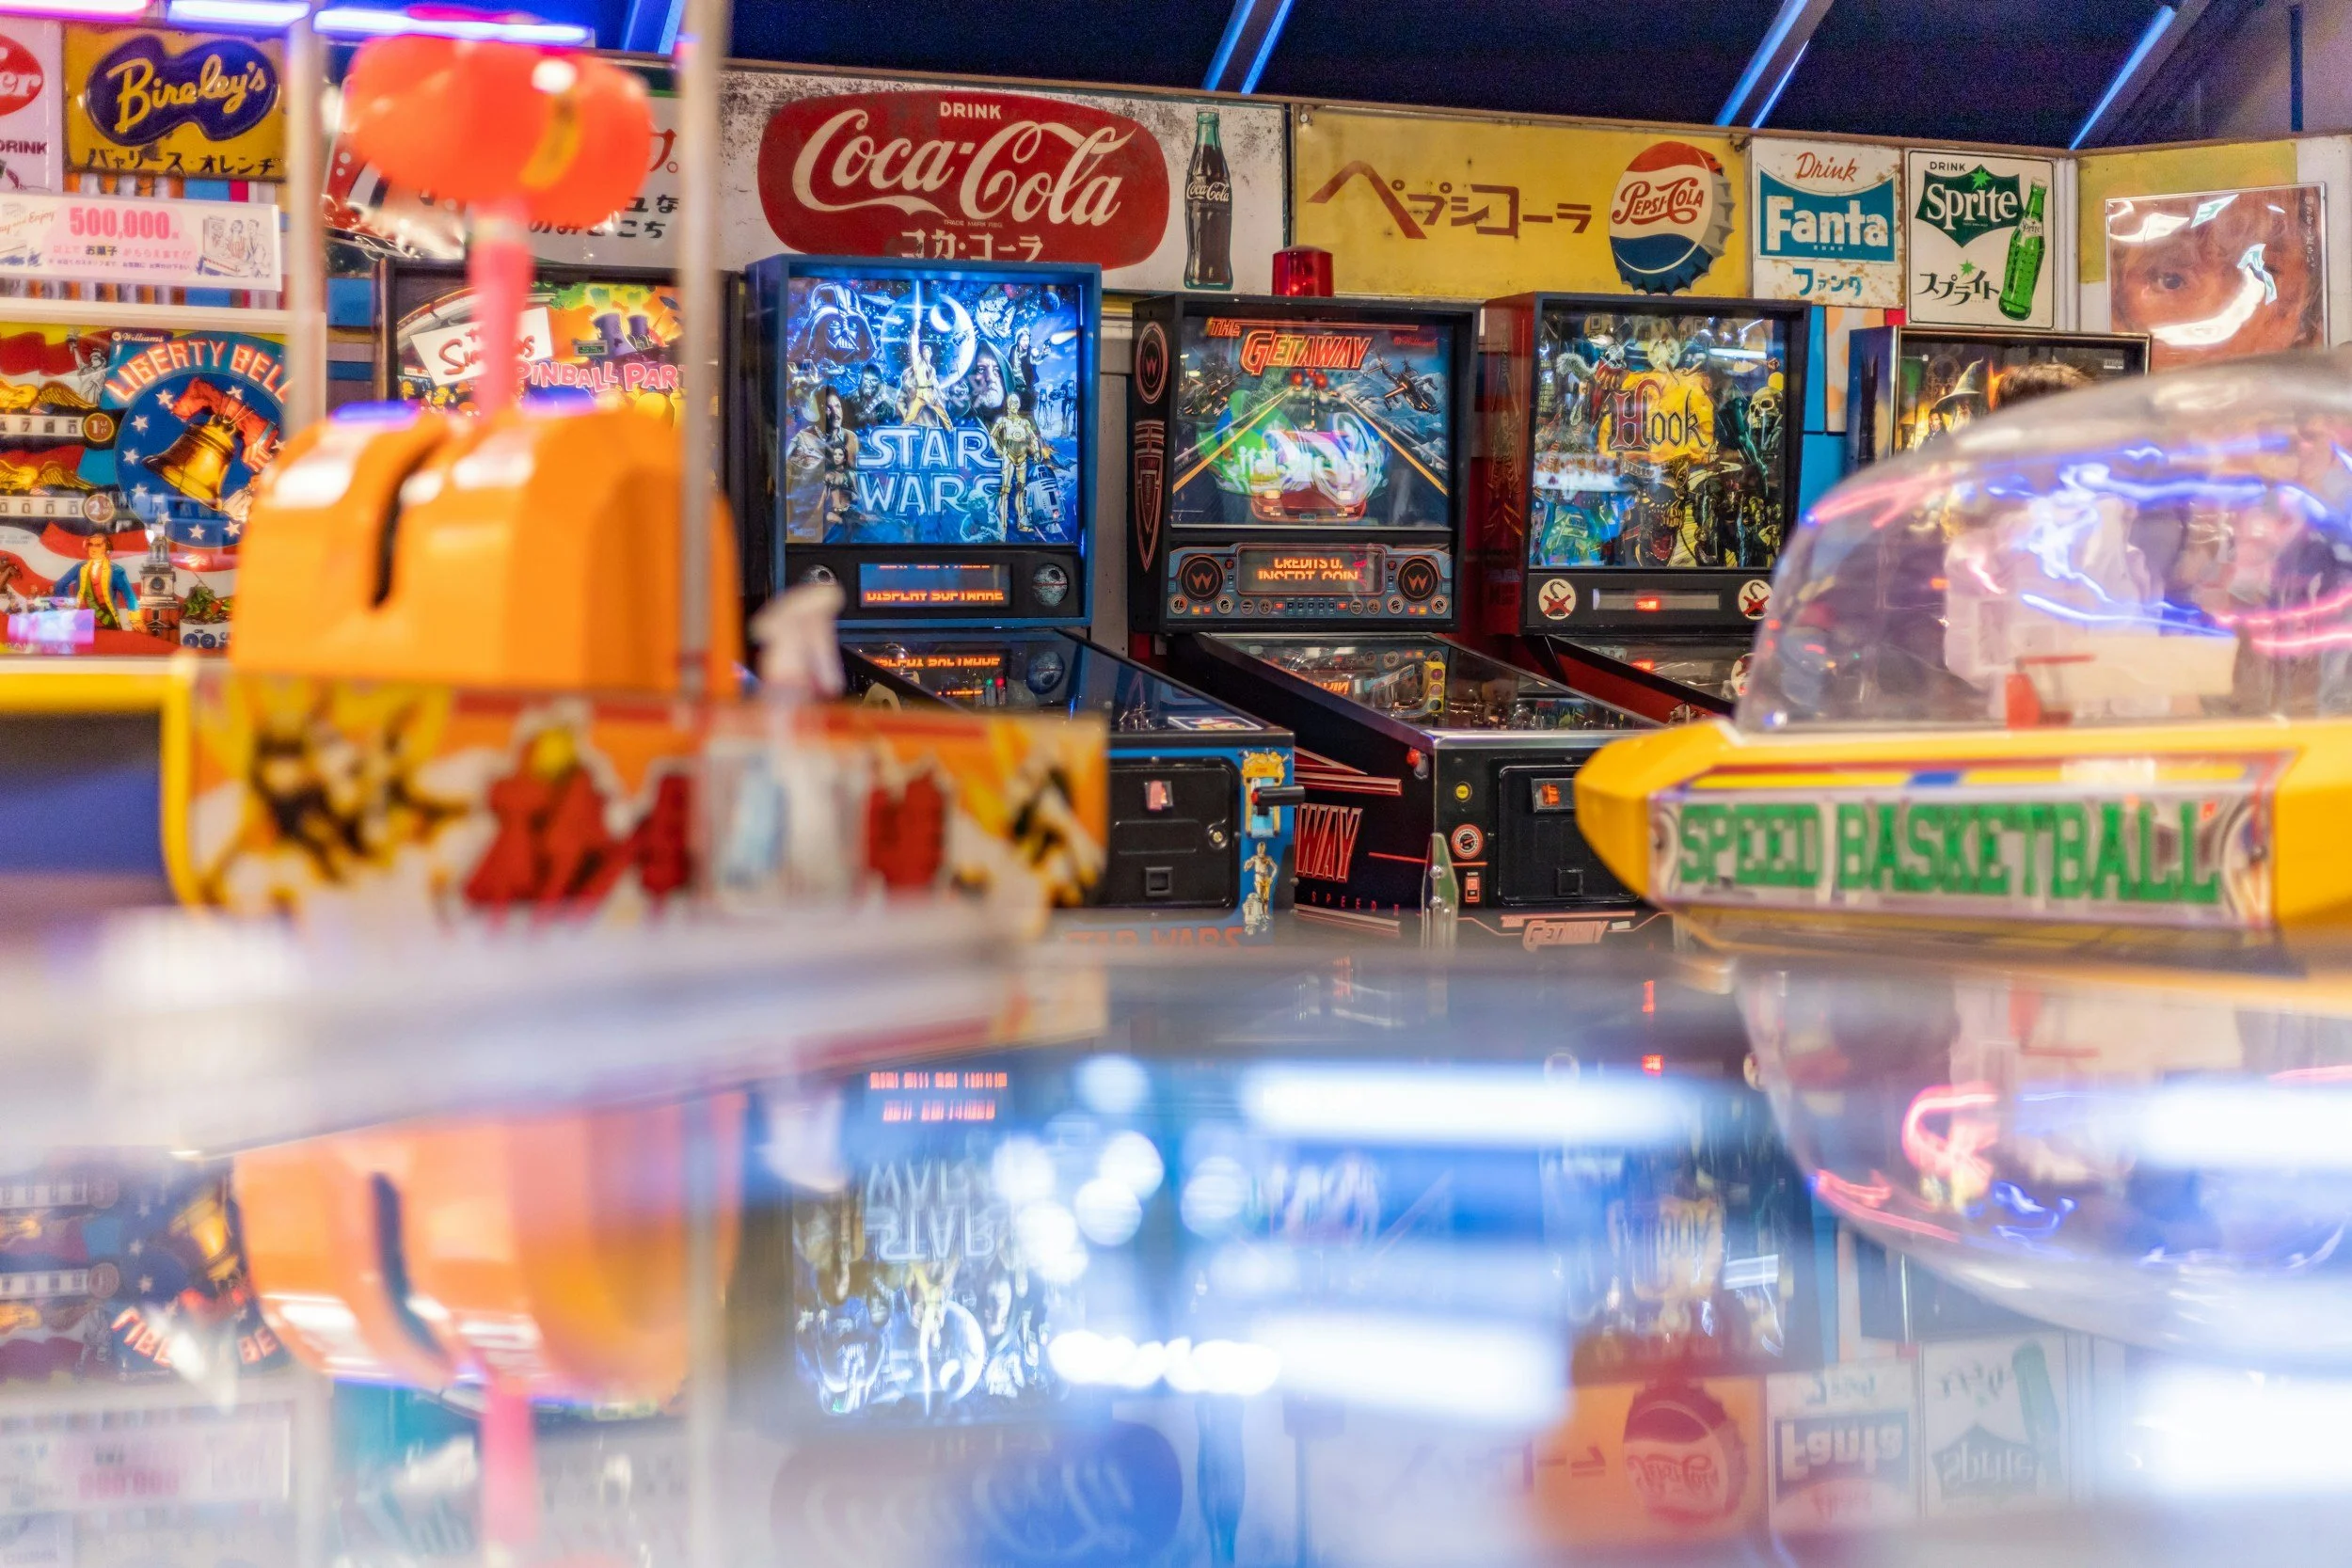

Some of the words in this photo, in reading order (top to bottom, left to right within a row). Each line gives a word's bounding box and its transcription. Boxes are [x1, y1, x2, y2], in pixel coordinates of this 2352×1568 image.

[106, 55, 266, 135] Bireley's
[940, 101, 1002, 120] DRINK
[792, 108, 1137, 226] Coca-Cola
[1795, 151, 1859, 182] Drink
[1930, 161, 1966, 172] DRINK
[1186, 182, 1230, 202] Coca-Cola
[1307, 161, 1592, 240] ペプシコーラ
[1926, 183, 2018, 230] Sprite
[70, 207, 170, 240] 500,000
[1766, 195, 1889, 251] Fanta
[2023, 220, 2042, 233] Sprite
[901, 229, 1043, 262] コカ・コーラ
[1792, 267, 1863, 299] ファンタ
[1915, 270, 2000, 307] スプライト
[121, 332, 165, 343] Williams
[1209, 320, 1242, 337] THE
[1239, 329, 1374, 376] GETAWAY
[104, 339, 228, 403] LIBERTY
[514, 359, 618, 393] PINBALL
[623, 361, 687, 392] PAR
[1609, 378, 1708, 451] Hook
[856, 425, 1007, 470] STAR
[1679, 801, 1823, 887] SPEED
[1837, 800, 2221, 903] BASKETBALL
[1311, 891, 1377, 911] SPEED
